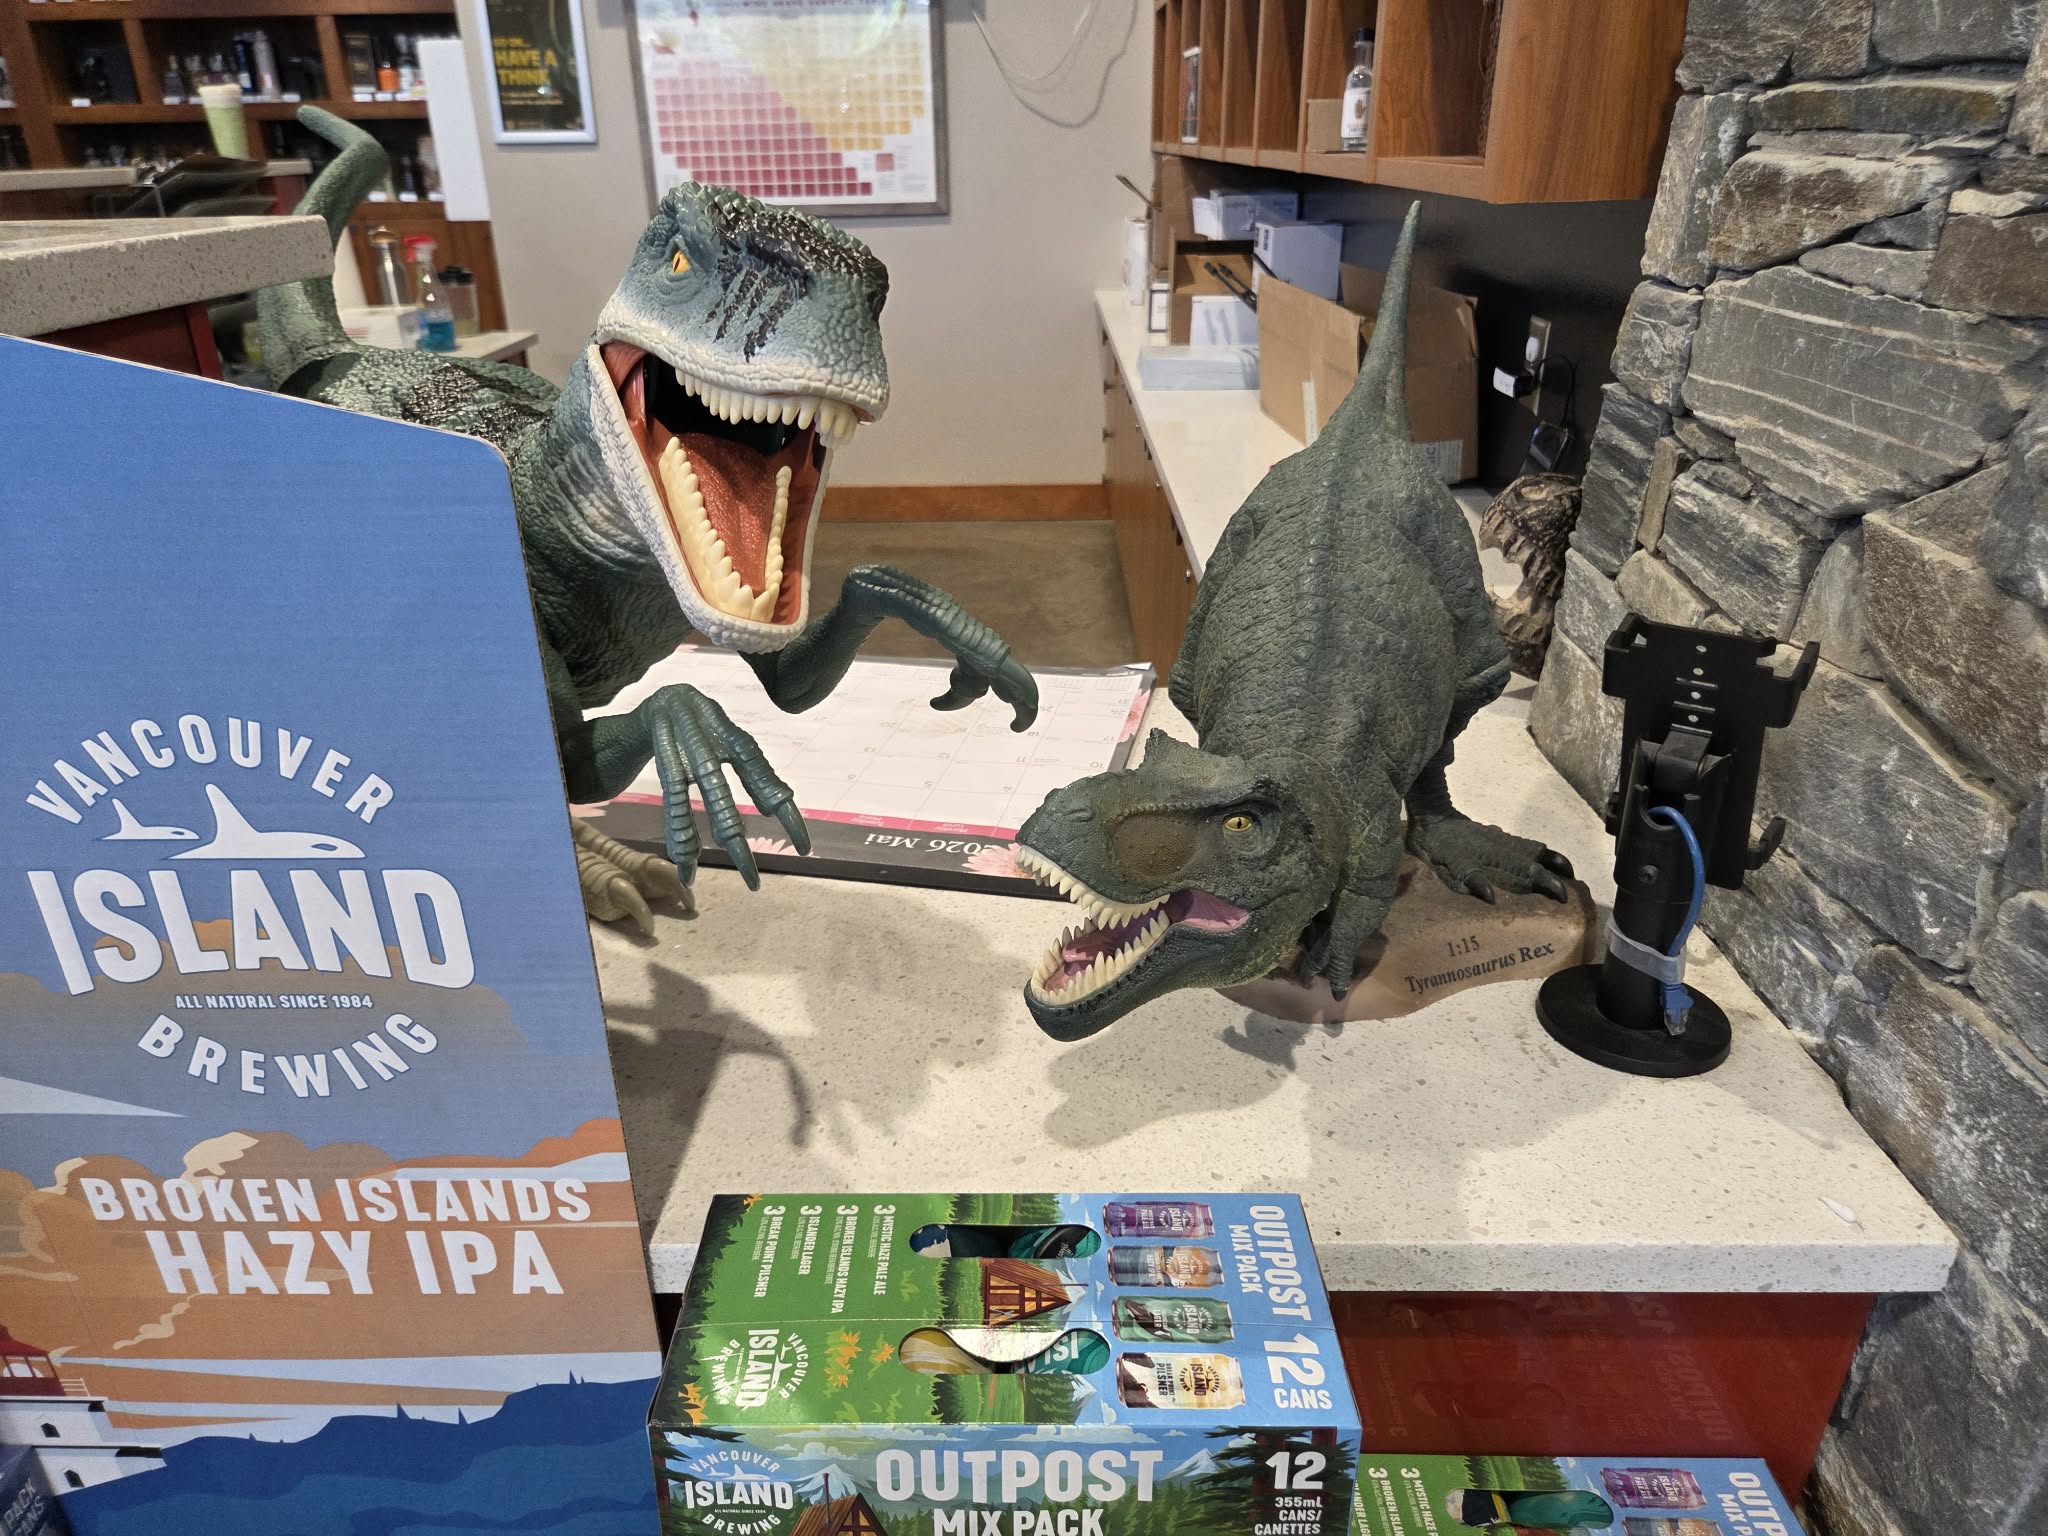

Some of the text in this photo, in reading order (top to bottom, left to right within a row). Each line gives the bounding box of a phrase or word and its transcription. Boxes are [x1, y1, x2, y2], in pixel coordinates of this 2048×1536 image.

[494, 49, 558, 66] HAVE A
[497, 69, 551, 86] THINK
[26, 713, 395, 824] VANCOUVER
[1090, 761, 1104, 769] 10
[924, 780, 933, 788] 5
[864, 833, 921, 849] Mai
[27, 869, 475, 996] ISLAND
[1446, 936, 1480, 957] 1:15
[1405, 943, 1555, 994] Tyrannosaurus Rex
[175, 995, 374, 1009] ALL NATURAL SINCE 1984
[137, 1013, 438, 1098] BREWING
[79, 1177, 592, 1222] BROKEN ISLANDS
[763, 1205, 786, 1215] 3
[800, 1205, 822, 1215] 3
[837, 1205, 859, 1215] 3
[874, 1205, 896, 1215] 3
[767, 1216, 784, 1240] BREAK
[803, 1216, 820, 1251] ISLANDER
[843, 1216, 858, 1244] BROKEN
[1168, 1208, 1184, 1231] ISLAND
[145, 1230, 564, 1294] HAZY IPA
[762, 1241, 778, 1263] POINT
[798, 1252, 814, 1275] LAGER
[837, 1245, 853, 1277] ISLANDS
[873, 1216, 895, 1296] MYSTIC HAZE PALE ALE
[1228, 1224, 1263, 1294] MIX PACK
[1250, 1205, 1312, 1321] OUTPOST
[753, 1264, 772, 1298] PILSNER
[833, 1277, 848, 1299] HAZY
[831, 1299, 845, 1314] IPA
[1183, 1304, 1199, 1334] ISLAND
[734, 1329, 780, 1407] ISLAND
[779, 1332, 809, 1399] VANCOUVER
[1263, 1333, 1325, 1386] 12
[1156, 1363, 1168, 1396] PILSNER
[1190, 1363, 1207, 1396] ISLAND
[1273, 1388, 1333, 1410] CANS
[689, 1450, 781, 1473] VANCOUVER
[875, 1448, 1164, 1503] OUTPOST
[1265, 1451, 1326, 1490] 12
[1368, 1467, 1388, 1478] 3
[1401, 1467, 1420, 1478] 3
[684, 1480, 794, 1510] ISLAND
[1274, 1496, 1323, 1508] 355mL
[1353, 1480, 1366, 1518] ANDER
[1380, 1480, 1398, 1512] BROKEN
[1657, 1475, 1679, 1502] ISLAND
[4, 1477, 35, 1531] PACK
[1279, 1509, 1322, 1522] CANS/
[1412, 1480, 1430, 1510] MYSTIC
[1421, 1511, 1437, 1531] HAZE
[1716, 1494, 1747, 1522] MIX
[702, 1513, 781, 1536] BREWING
[933, 1508, 1104, 1536] MIX PACK
[1254, 1523, 1321, 1536] CANETTES
